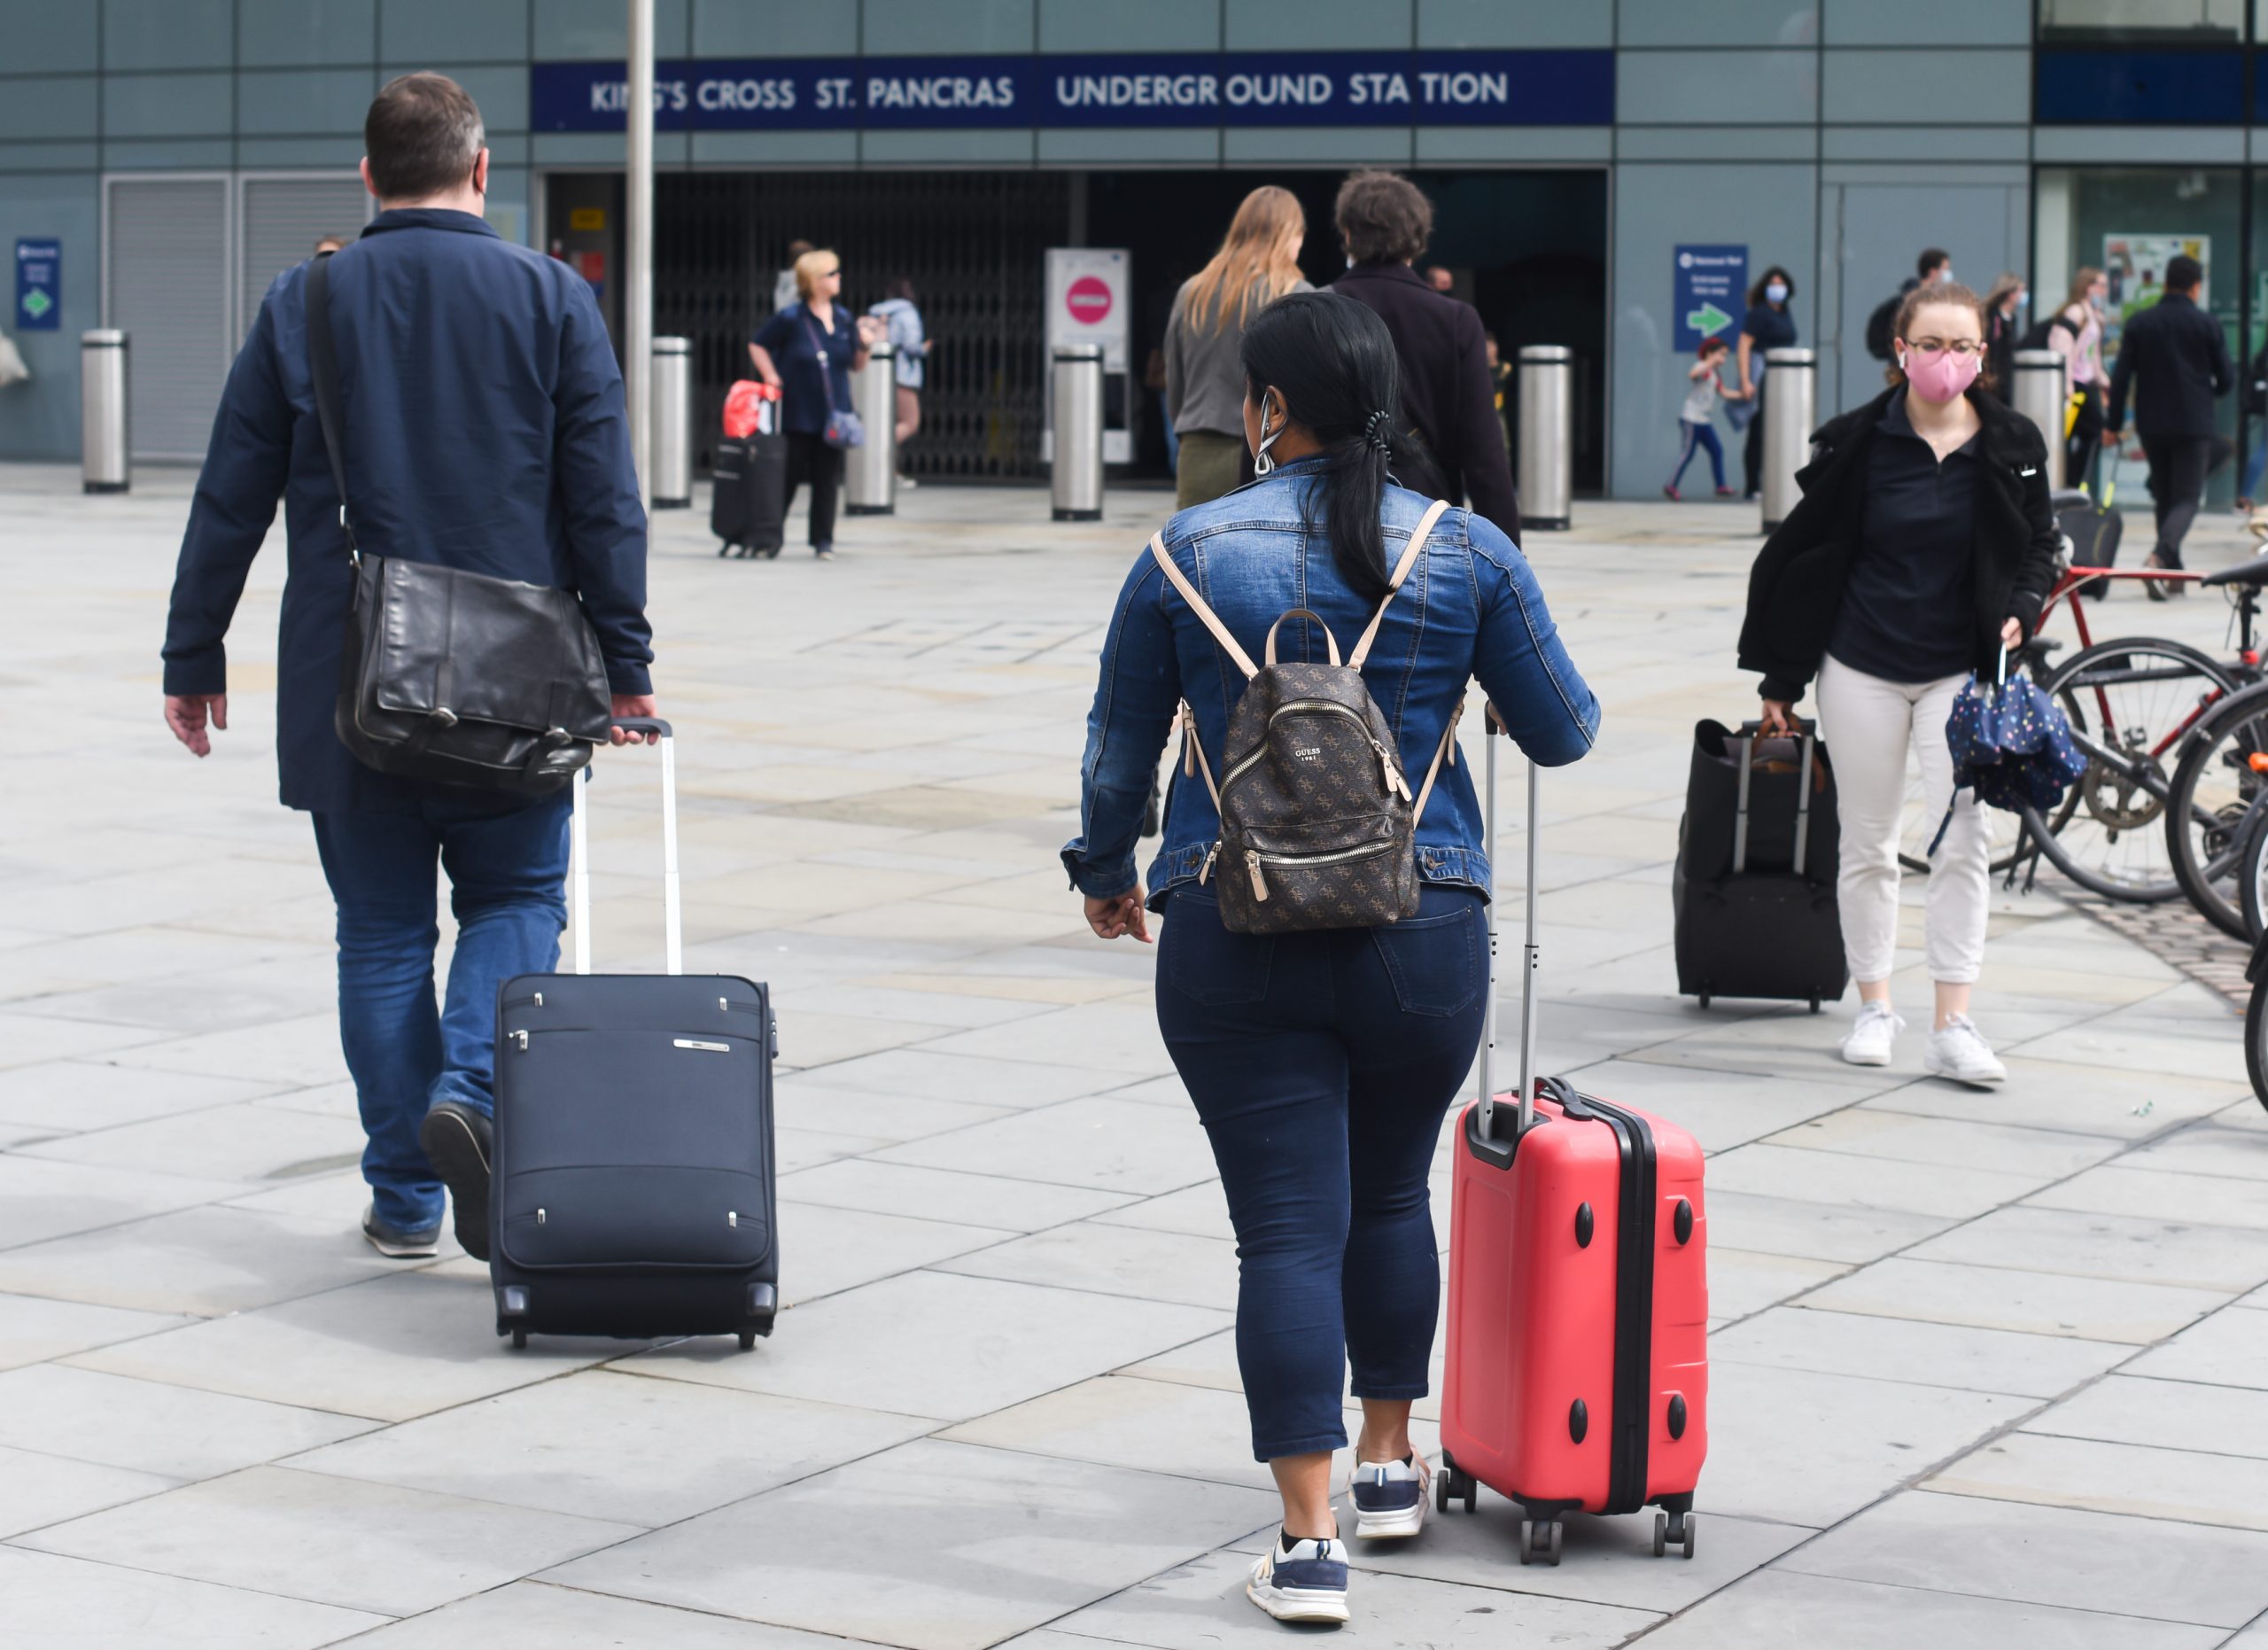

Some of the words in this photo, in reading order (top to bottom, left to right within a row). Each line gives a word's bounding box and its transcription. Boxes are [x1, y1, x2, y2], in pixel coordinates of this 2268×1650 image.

[697, 80, 796, 110] CROSS
[816, 79, 856, 108] ST.
[867, 77, 1014, 107] PANCRAS
[1057, 74, 1332, 106] UNDERGROUND
[1348, 73, 1508, 105] STATION
[1295, 747, 1321, 757] GUESS
